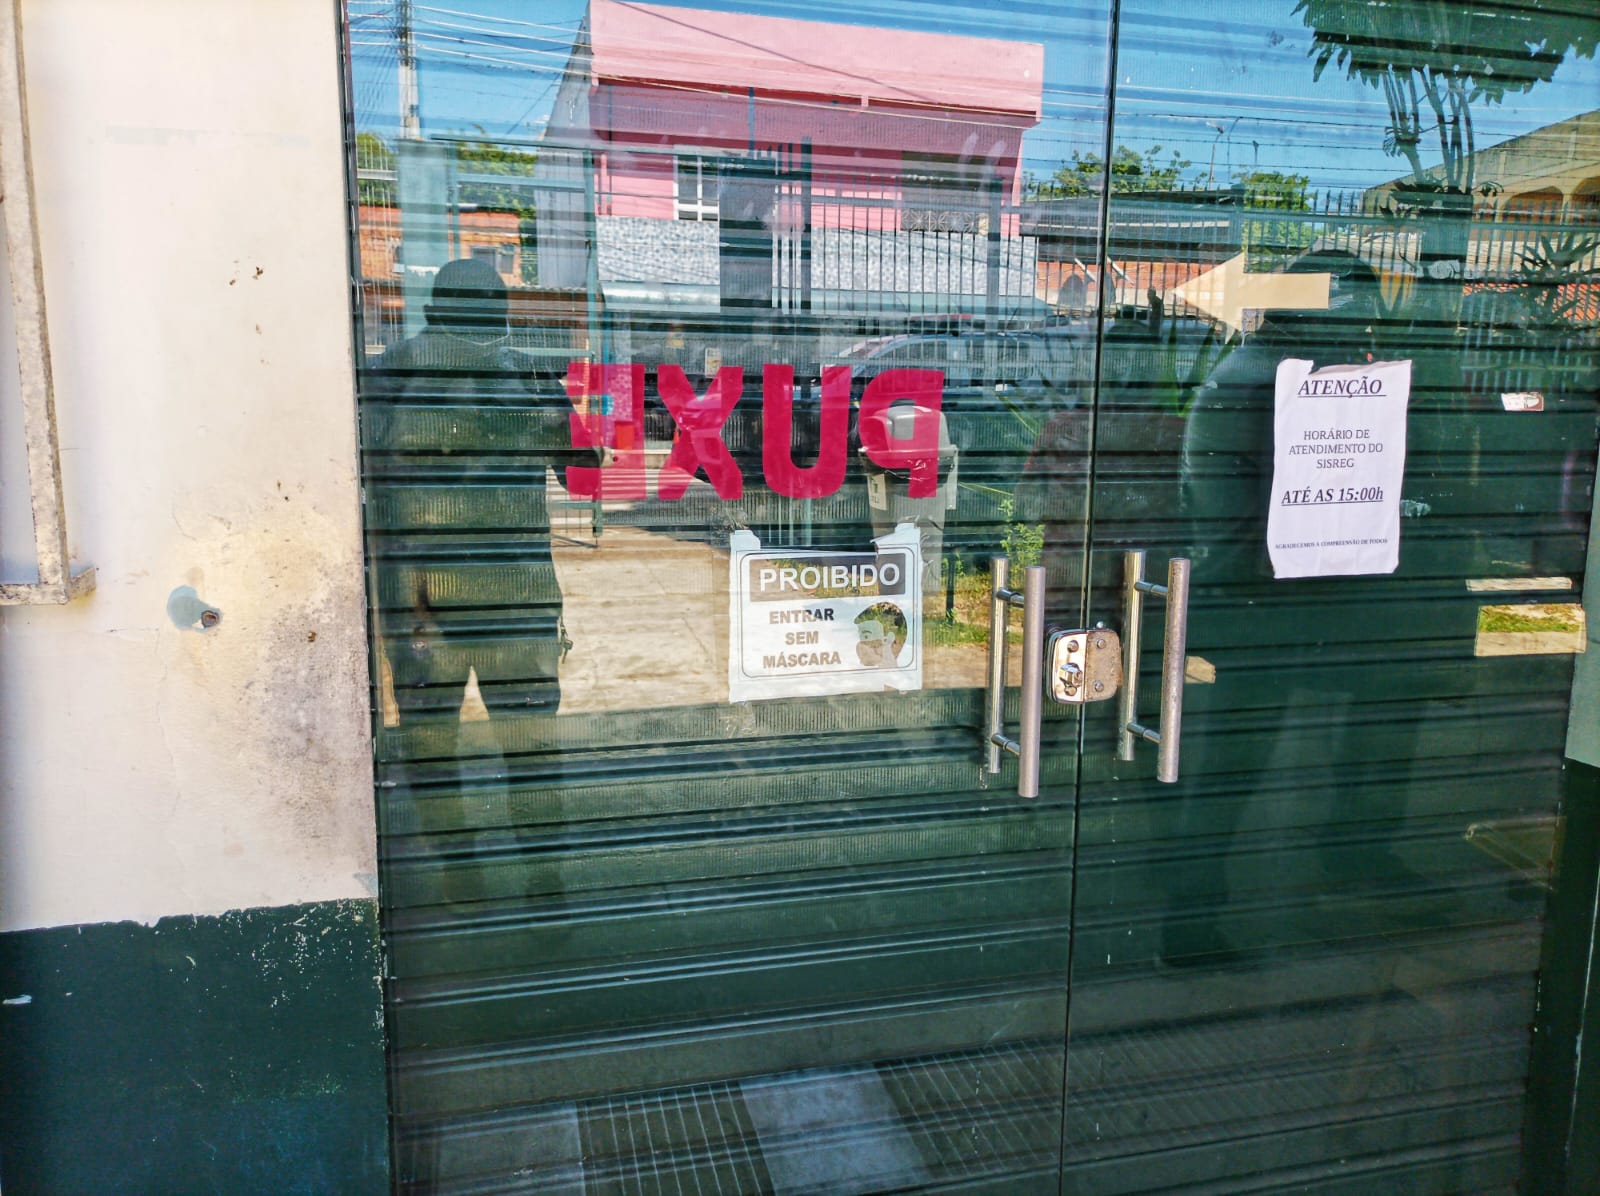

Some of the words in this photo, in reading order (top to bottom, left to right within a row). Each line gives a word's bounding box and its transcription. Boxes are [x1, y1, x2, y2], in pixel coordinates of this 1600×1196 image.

[1298, 375, 1383, 398] ATENÇÃO
[1303, 428, 1353, 440] HORÁRIO
[1355, 429, 1370, 439] DE
[1288, 443, 1366, 455] ATENDIMENTO
[1368, 442, 1384, 453] DO
[1316, 458, 1355, 469] SISREG
[1281, 486, 1311, 505] ATÉ
[1313, 488, 1334, 503] AS
[1337, 486, 1384, 503] 15:00h
[758, 563, 900, 593] PROIBIDO
[769, 608, 835, 625] ENTRAR
[785, 631, 819, 645] SEM
[763, 651, 841, 669] MÁSCARA
